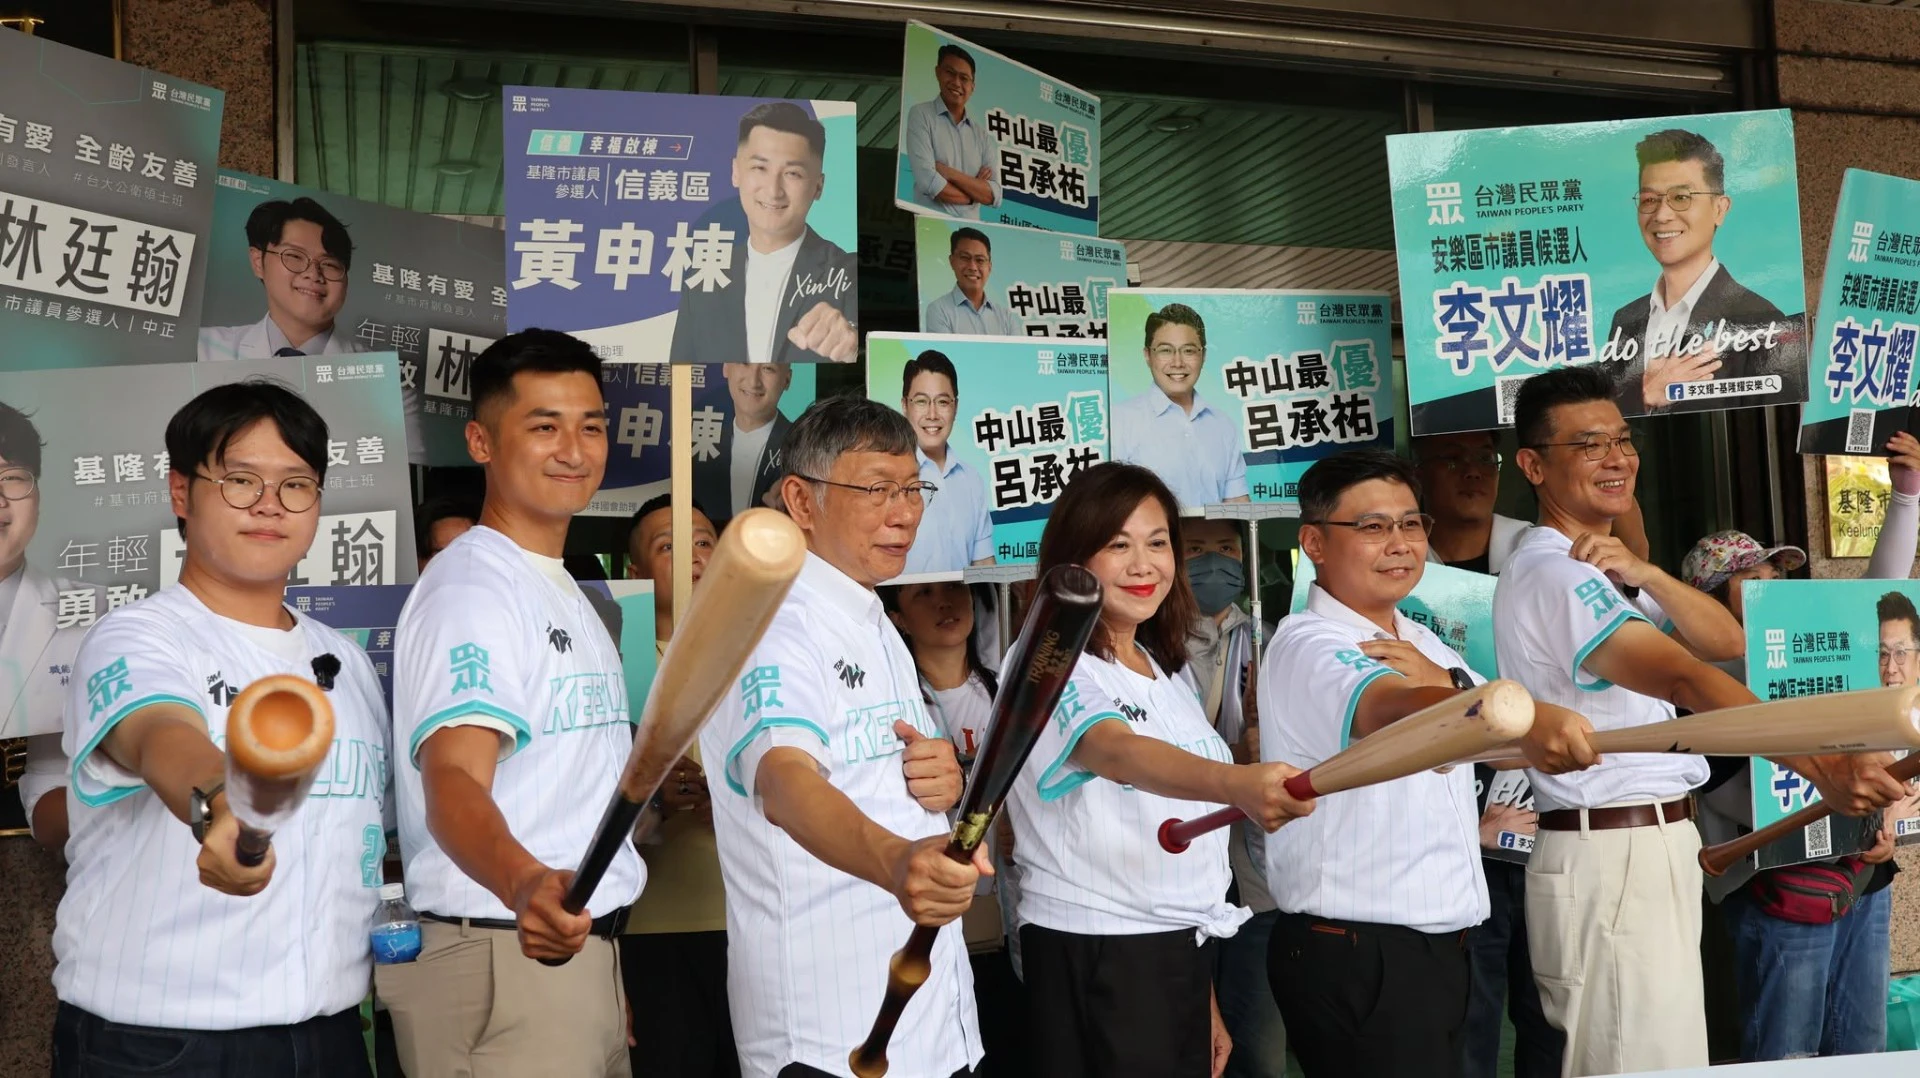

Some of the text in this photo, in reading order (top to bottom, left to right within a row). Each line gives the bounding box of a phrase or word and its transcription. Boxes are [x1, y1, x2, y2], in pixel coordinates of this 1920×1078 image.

[1054, 88, 1096, 116] 台灣民眾黨
[589, 136, 659, 156] 幸福啟棟
[987, 111, 1089, 167] 中山最優
[0, 153, 50, 178] 發言人
[74, 134, 198, 188] 全齡友善
[526, 165, 600, 182] 基隆市議員
[1001, 151, 1086, 205] 呂承祐
[555, 183, 599, 200] 參選人
[615, 168, 711, 201] 信義區
[1426, 182, 1465, 226] 眾
[1475, 178, 1583, 208] 台灣民眾黨
[1476, 204, 1585, 218] TAIWAN PEOPLE'S PARTY
[0, 199, 182, 308] 林廷翰
[511, 218, 735, 293] 黃申棟
[1076, 243, 1121, 262] 台灣民眾黨
[1432, 225, 1588, 274] 安樂區市議員候選人
[372, 262, 475, 302] 基隆有愛
[0, 294, 177, 339] 市議員參選人 中正
[1319, 302, 1384, 319] 台灣民眾黨
[1439, 278, 1592, 371] 李文耀
[356, 318, 421, 355] 年輕
[1599, 317, 1781, 363] do the best
[1057, 352, 1109, 368] 台灣民眾黨
[1225, 345, 1375, 397] 中山最優
[1828, 321, 1913, 402] 李文耀
[975, 394, 1105, 452] 中山最優
[1247, 394, 1374, 450] 呂承祐
[57, 534, 149, 578] 年輕
[1792, 631, 1850, 654] 台灣民眾黨
[1793, 654, 1851, 664] TAIWAN PEOPLE'S PARTY
